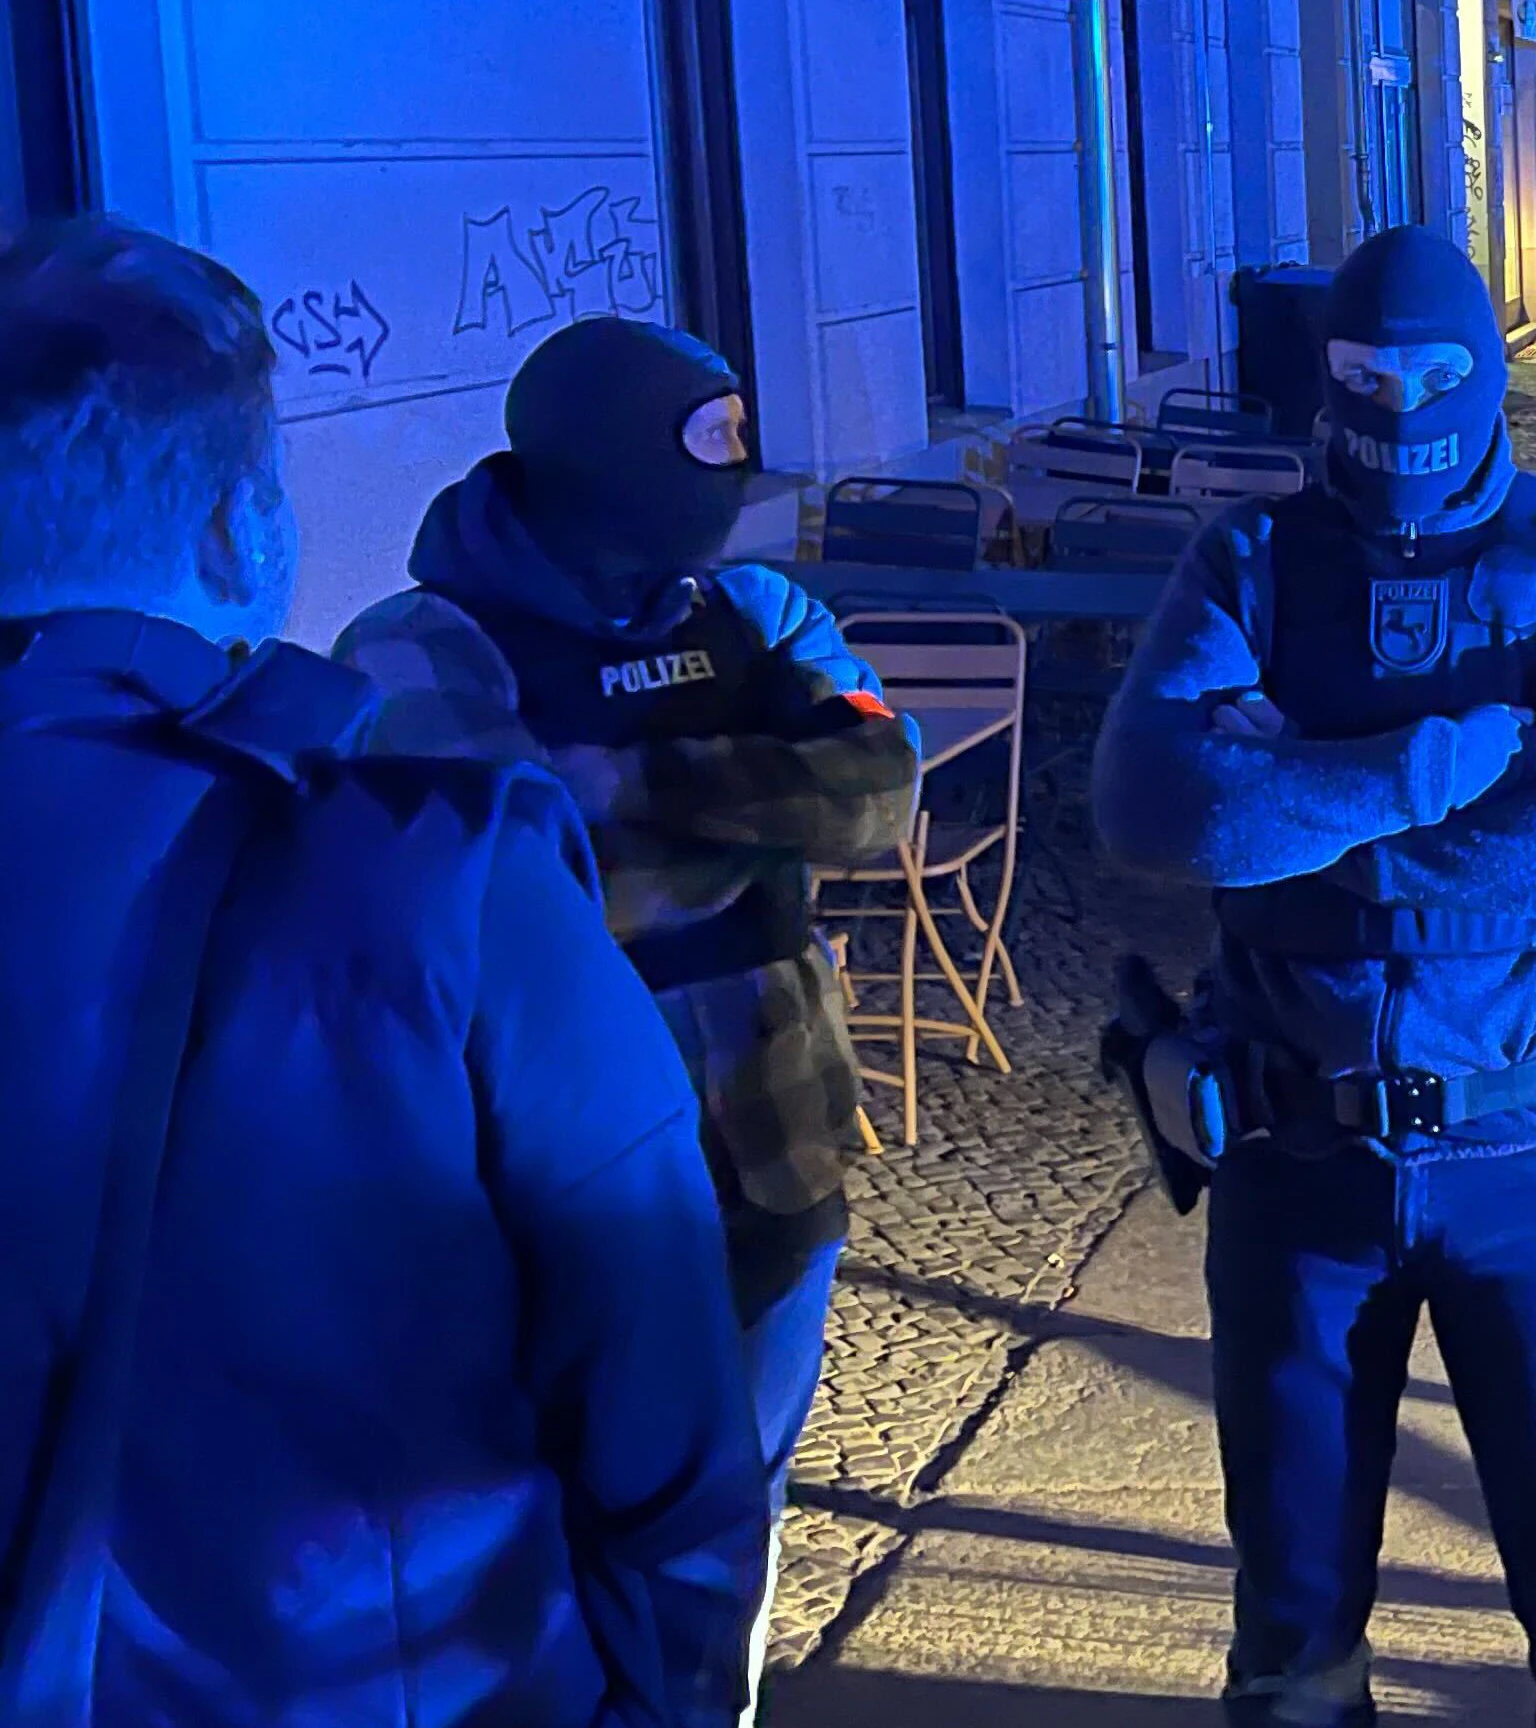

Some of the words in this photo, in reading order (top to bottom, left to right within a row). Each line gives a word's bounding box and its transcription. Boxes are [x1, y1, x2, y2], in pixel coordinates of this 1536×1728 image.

[1344, 427, 1458, 475] POLIZEI
[1377, 584, 1438, 601] POLIZEI
[600, 650, 716, 697] POLIZEI
